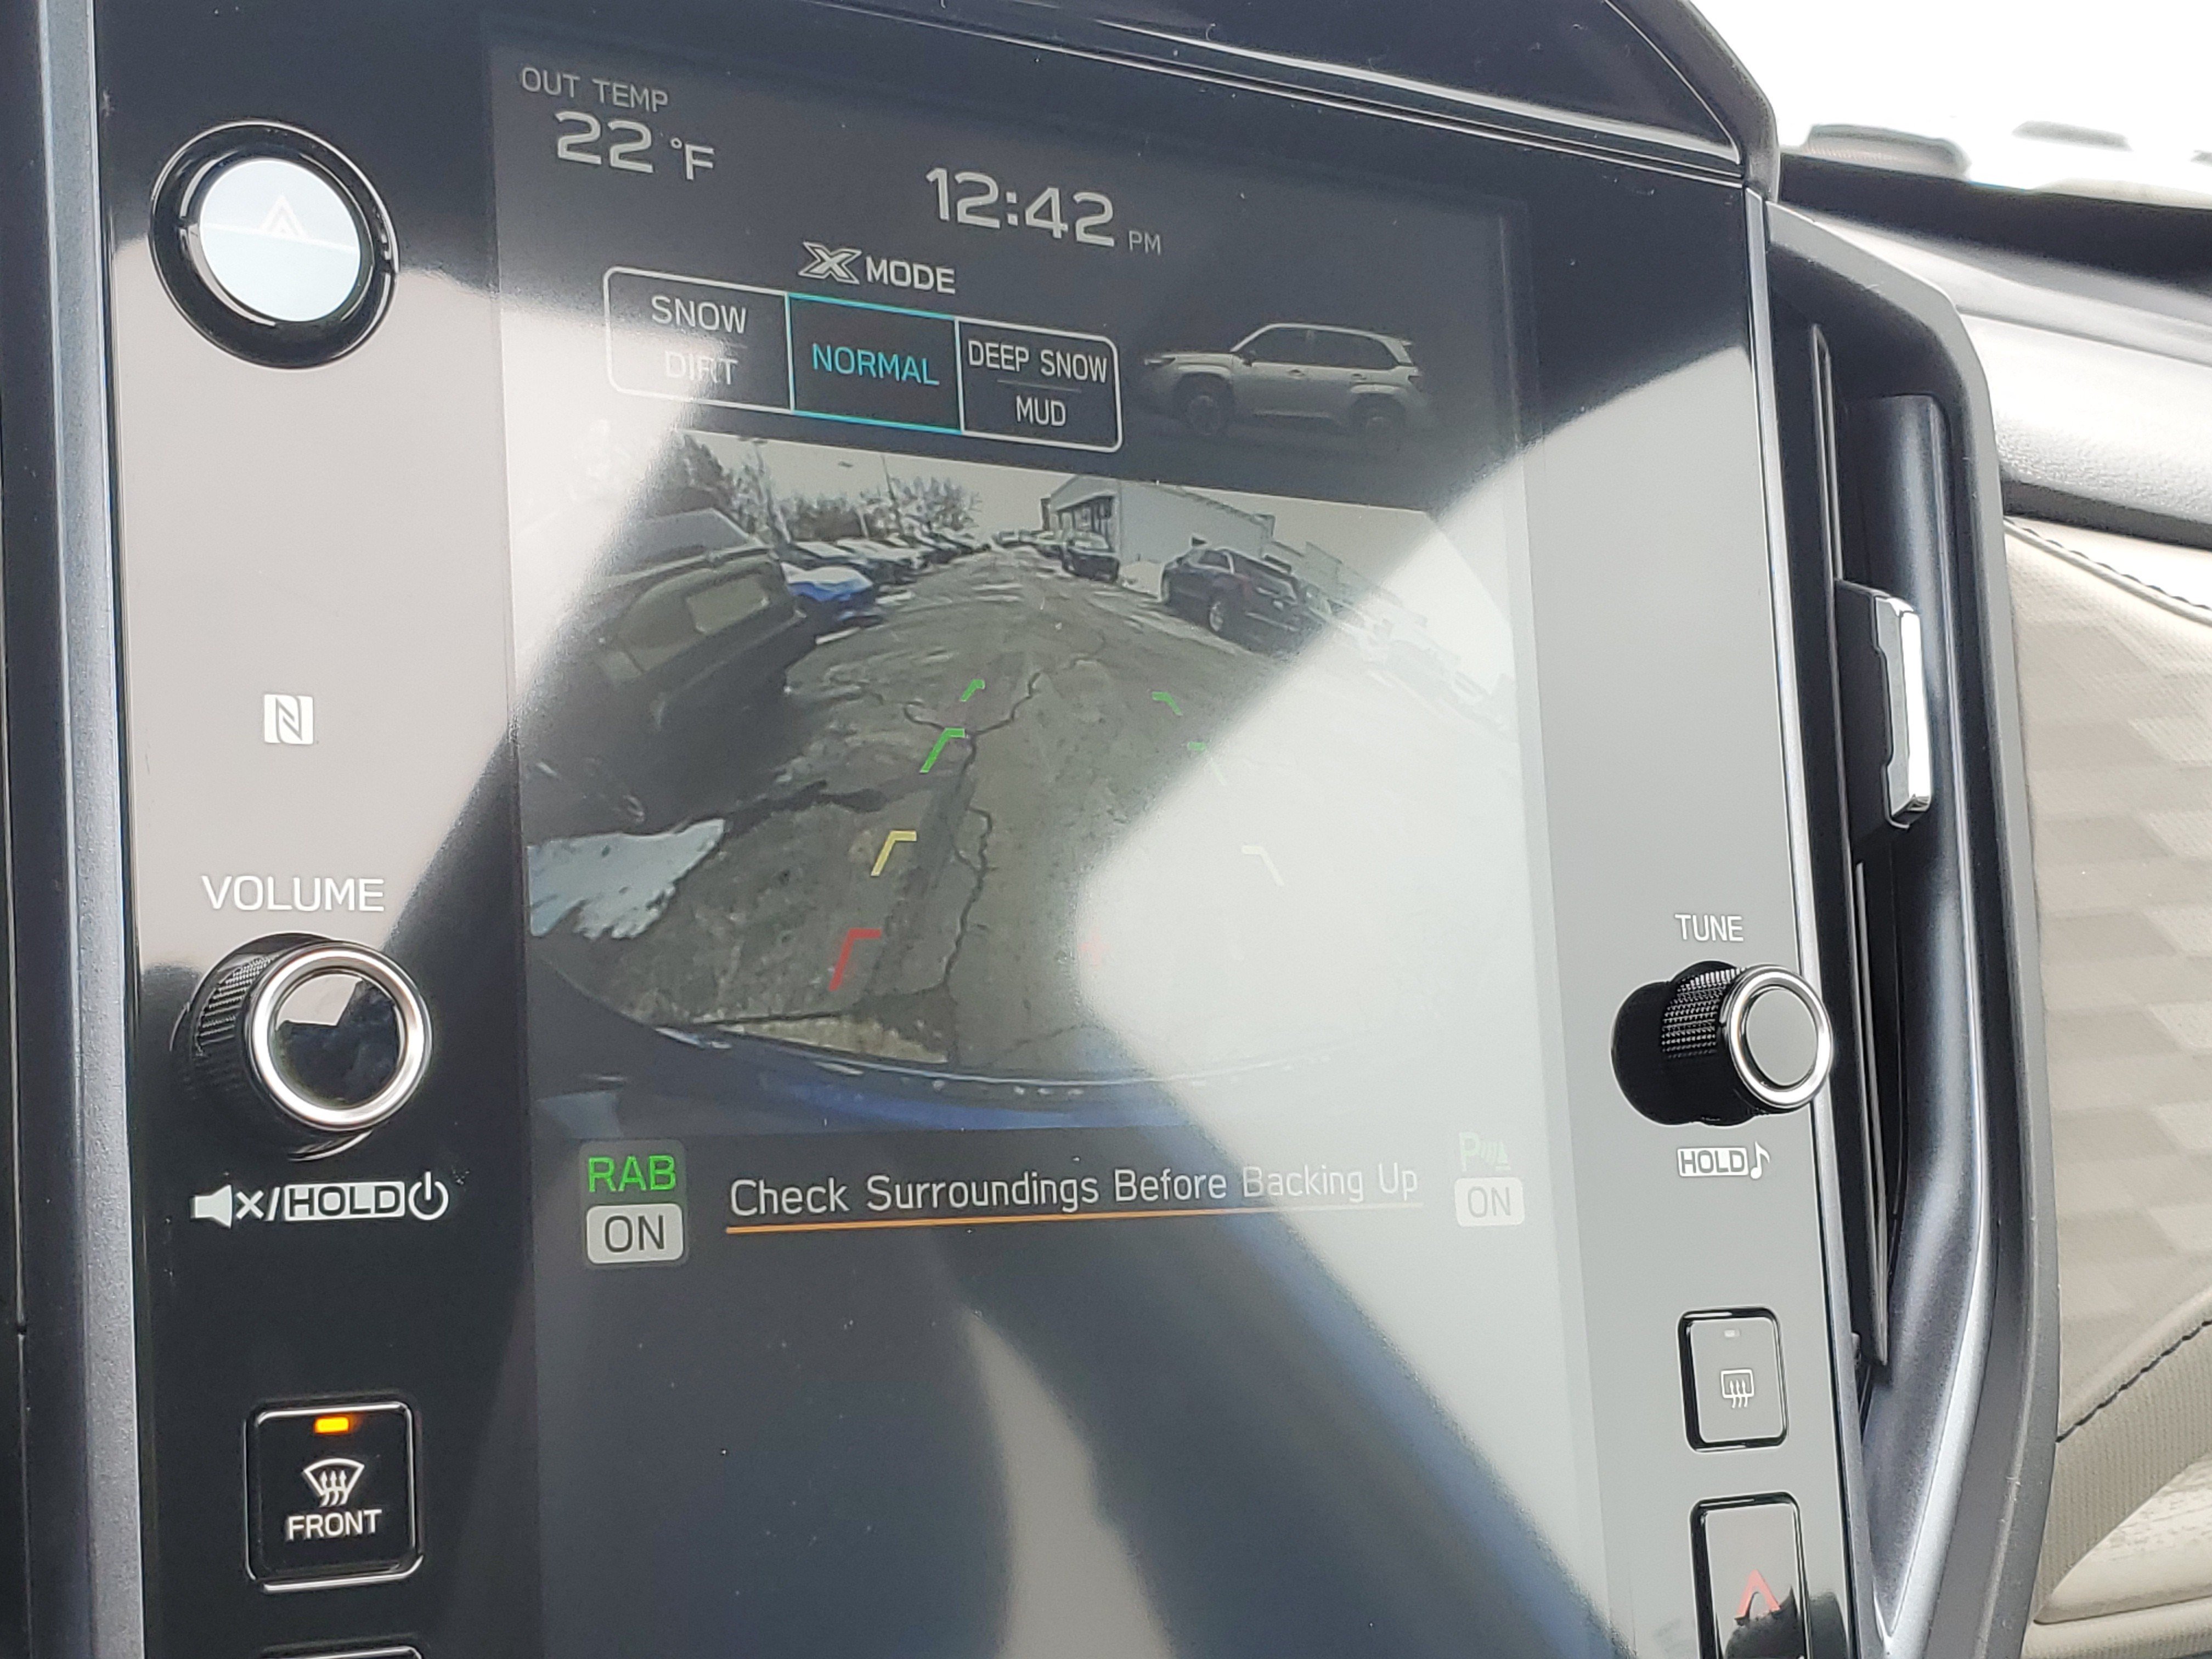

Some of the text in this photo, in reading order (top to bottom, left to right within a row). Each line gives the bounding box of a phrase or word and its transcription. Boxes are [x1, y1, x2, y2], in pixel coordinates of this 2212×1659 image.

[521, 66, 669, 112] OUT TEMP
[554, 110, 715, 180] 22 °F
[926, 167, 1163, 256] 12:42 PM
[865, 256, 956, 295] MODE
[650, 294, 747, 334] SNOW
[664, 349, 739, 385] DIRT
[812, 343, 940, 386] NORMAL
[968, 340, 1109, 383] DEEP SNOW
[1015, 395, 1067, 428] MUD
[201, 875, 385, 912] VOLUME
[1674, 913, 1745, 942] TUNE
[588, 1155, 677, 1192] RAB
[1679, 1149, 1746, 1174] HOLD
[729, 1162, 1419, 1216] Check Surroundings Before Backing Up
[1467, 1186, 1511, 1218] ON
[604, 1215, 665, 1254] ON
[285, 1509, 382, 1542] FRONT
